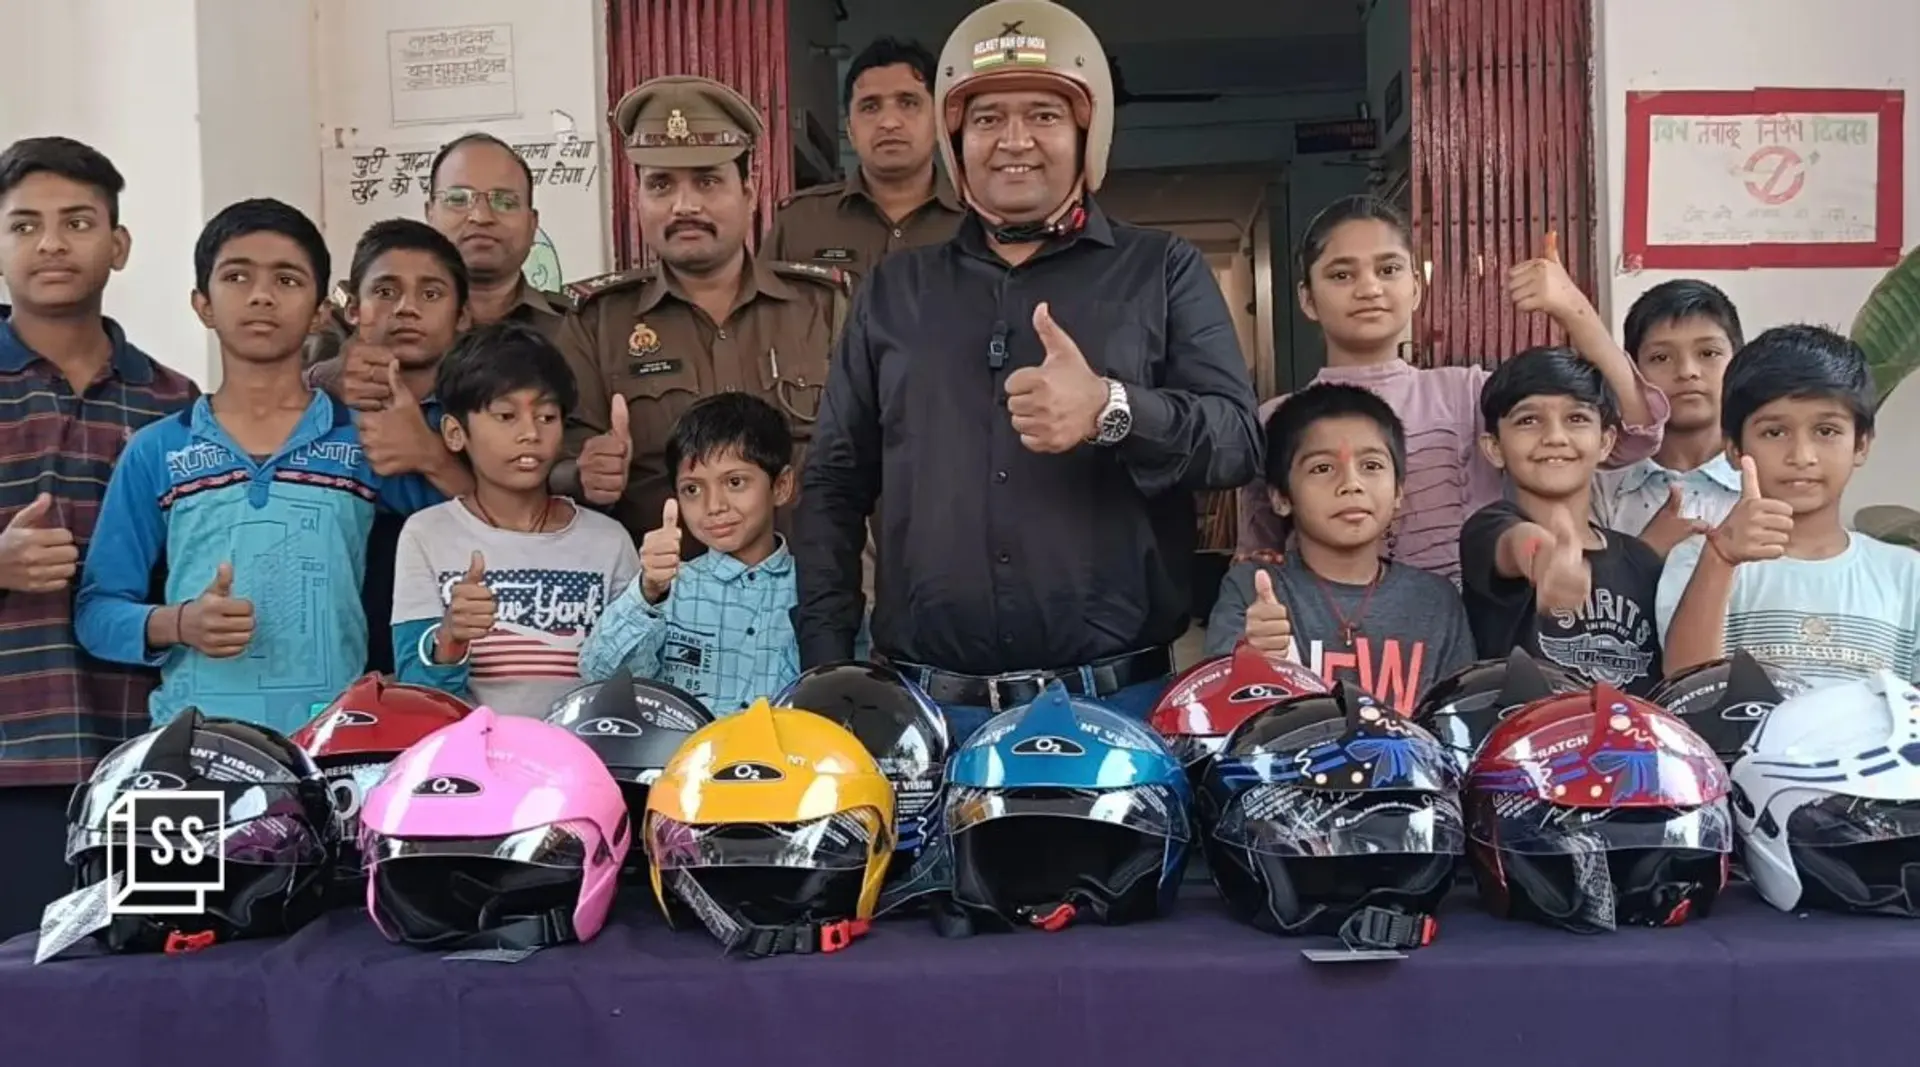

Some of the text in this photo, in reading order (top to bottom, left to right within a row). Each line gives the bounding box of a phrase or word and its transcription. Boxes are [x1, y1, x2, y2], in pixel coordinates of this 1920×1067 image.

[1551, 588, 1651, 646] SIRITS
[1667, 683, 1715, 711] CRATCH
[1527, 734, 1589, 759] RATCH
[222, 754, 266, 779] VISOR
